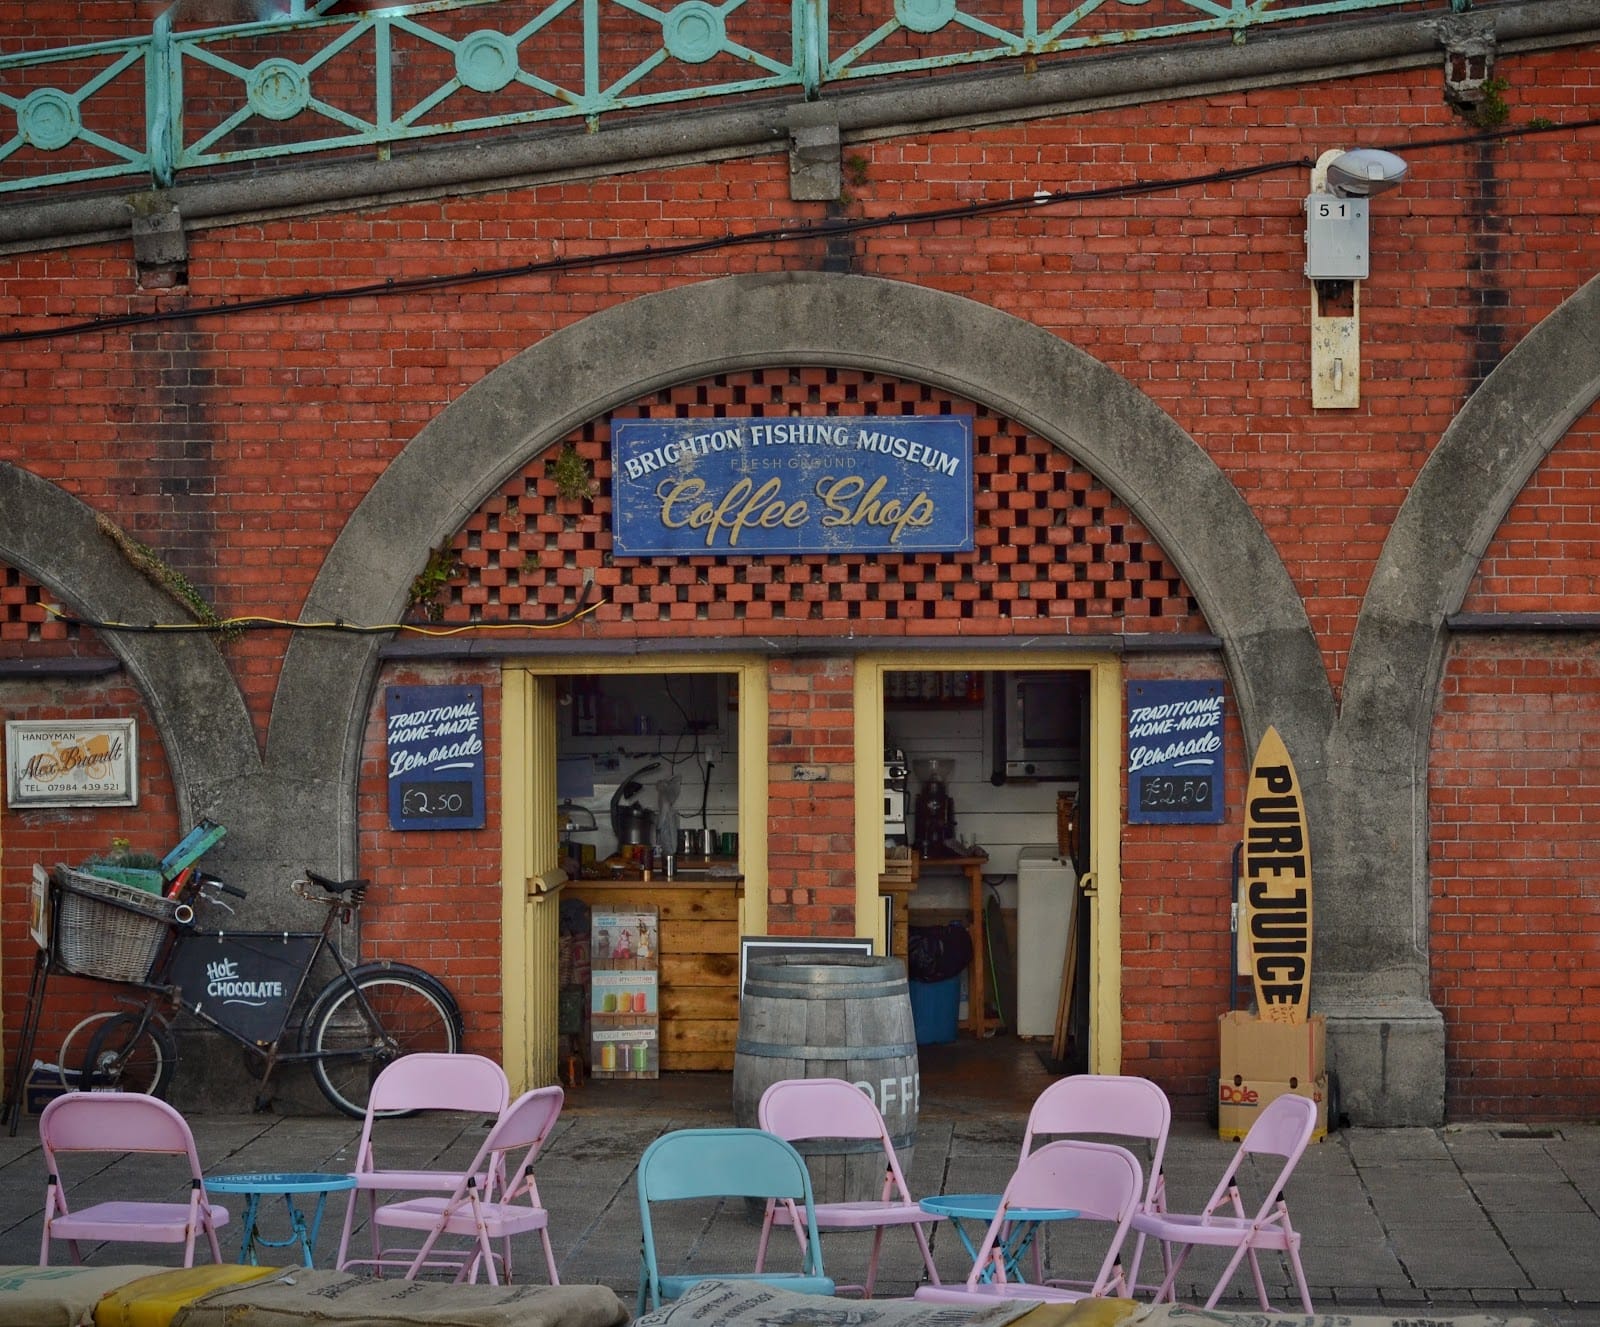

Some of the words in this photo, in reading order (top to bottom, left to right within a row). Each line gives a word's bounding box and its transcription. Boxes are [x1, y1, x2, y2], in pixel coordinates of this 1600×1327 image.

[624, 428, 743, 480] BRIGHTON
[750, 424, 848, 447] FISHING
[857, 429, 960, 477] MUSEUM
[730, 458, 782, 469] FRESH
[787, 457, 857, 469] GROUND
[656, 476, 810, 547] Coffee
[815, 475, 934, 544] Shop
[388, 702, 478, 730] TRADITIONAL
[1129, 696, 1225, 724] TRADITIONAL
[22, 733, 76, 741] HANDYMAN
[387, 717, 480, 745] HOME-MADE
[1129, 711, 1221, 739] HOME-MADE
[388, 733, 483, 779] Lemonade
[1128, 730, 1222, 773] Lemonade
[47, 784, 77, 792] 07984
[81, 783, 101, 791] 439
[1142, 777, 1209, 805] £2.50
[402, 789, 463, 815] £2.50
[206, 957, 239, 980] Hot
[207, 981, 282, 998] CHOCOLATE
[1220, 1085, 1259, 1103] Dole
